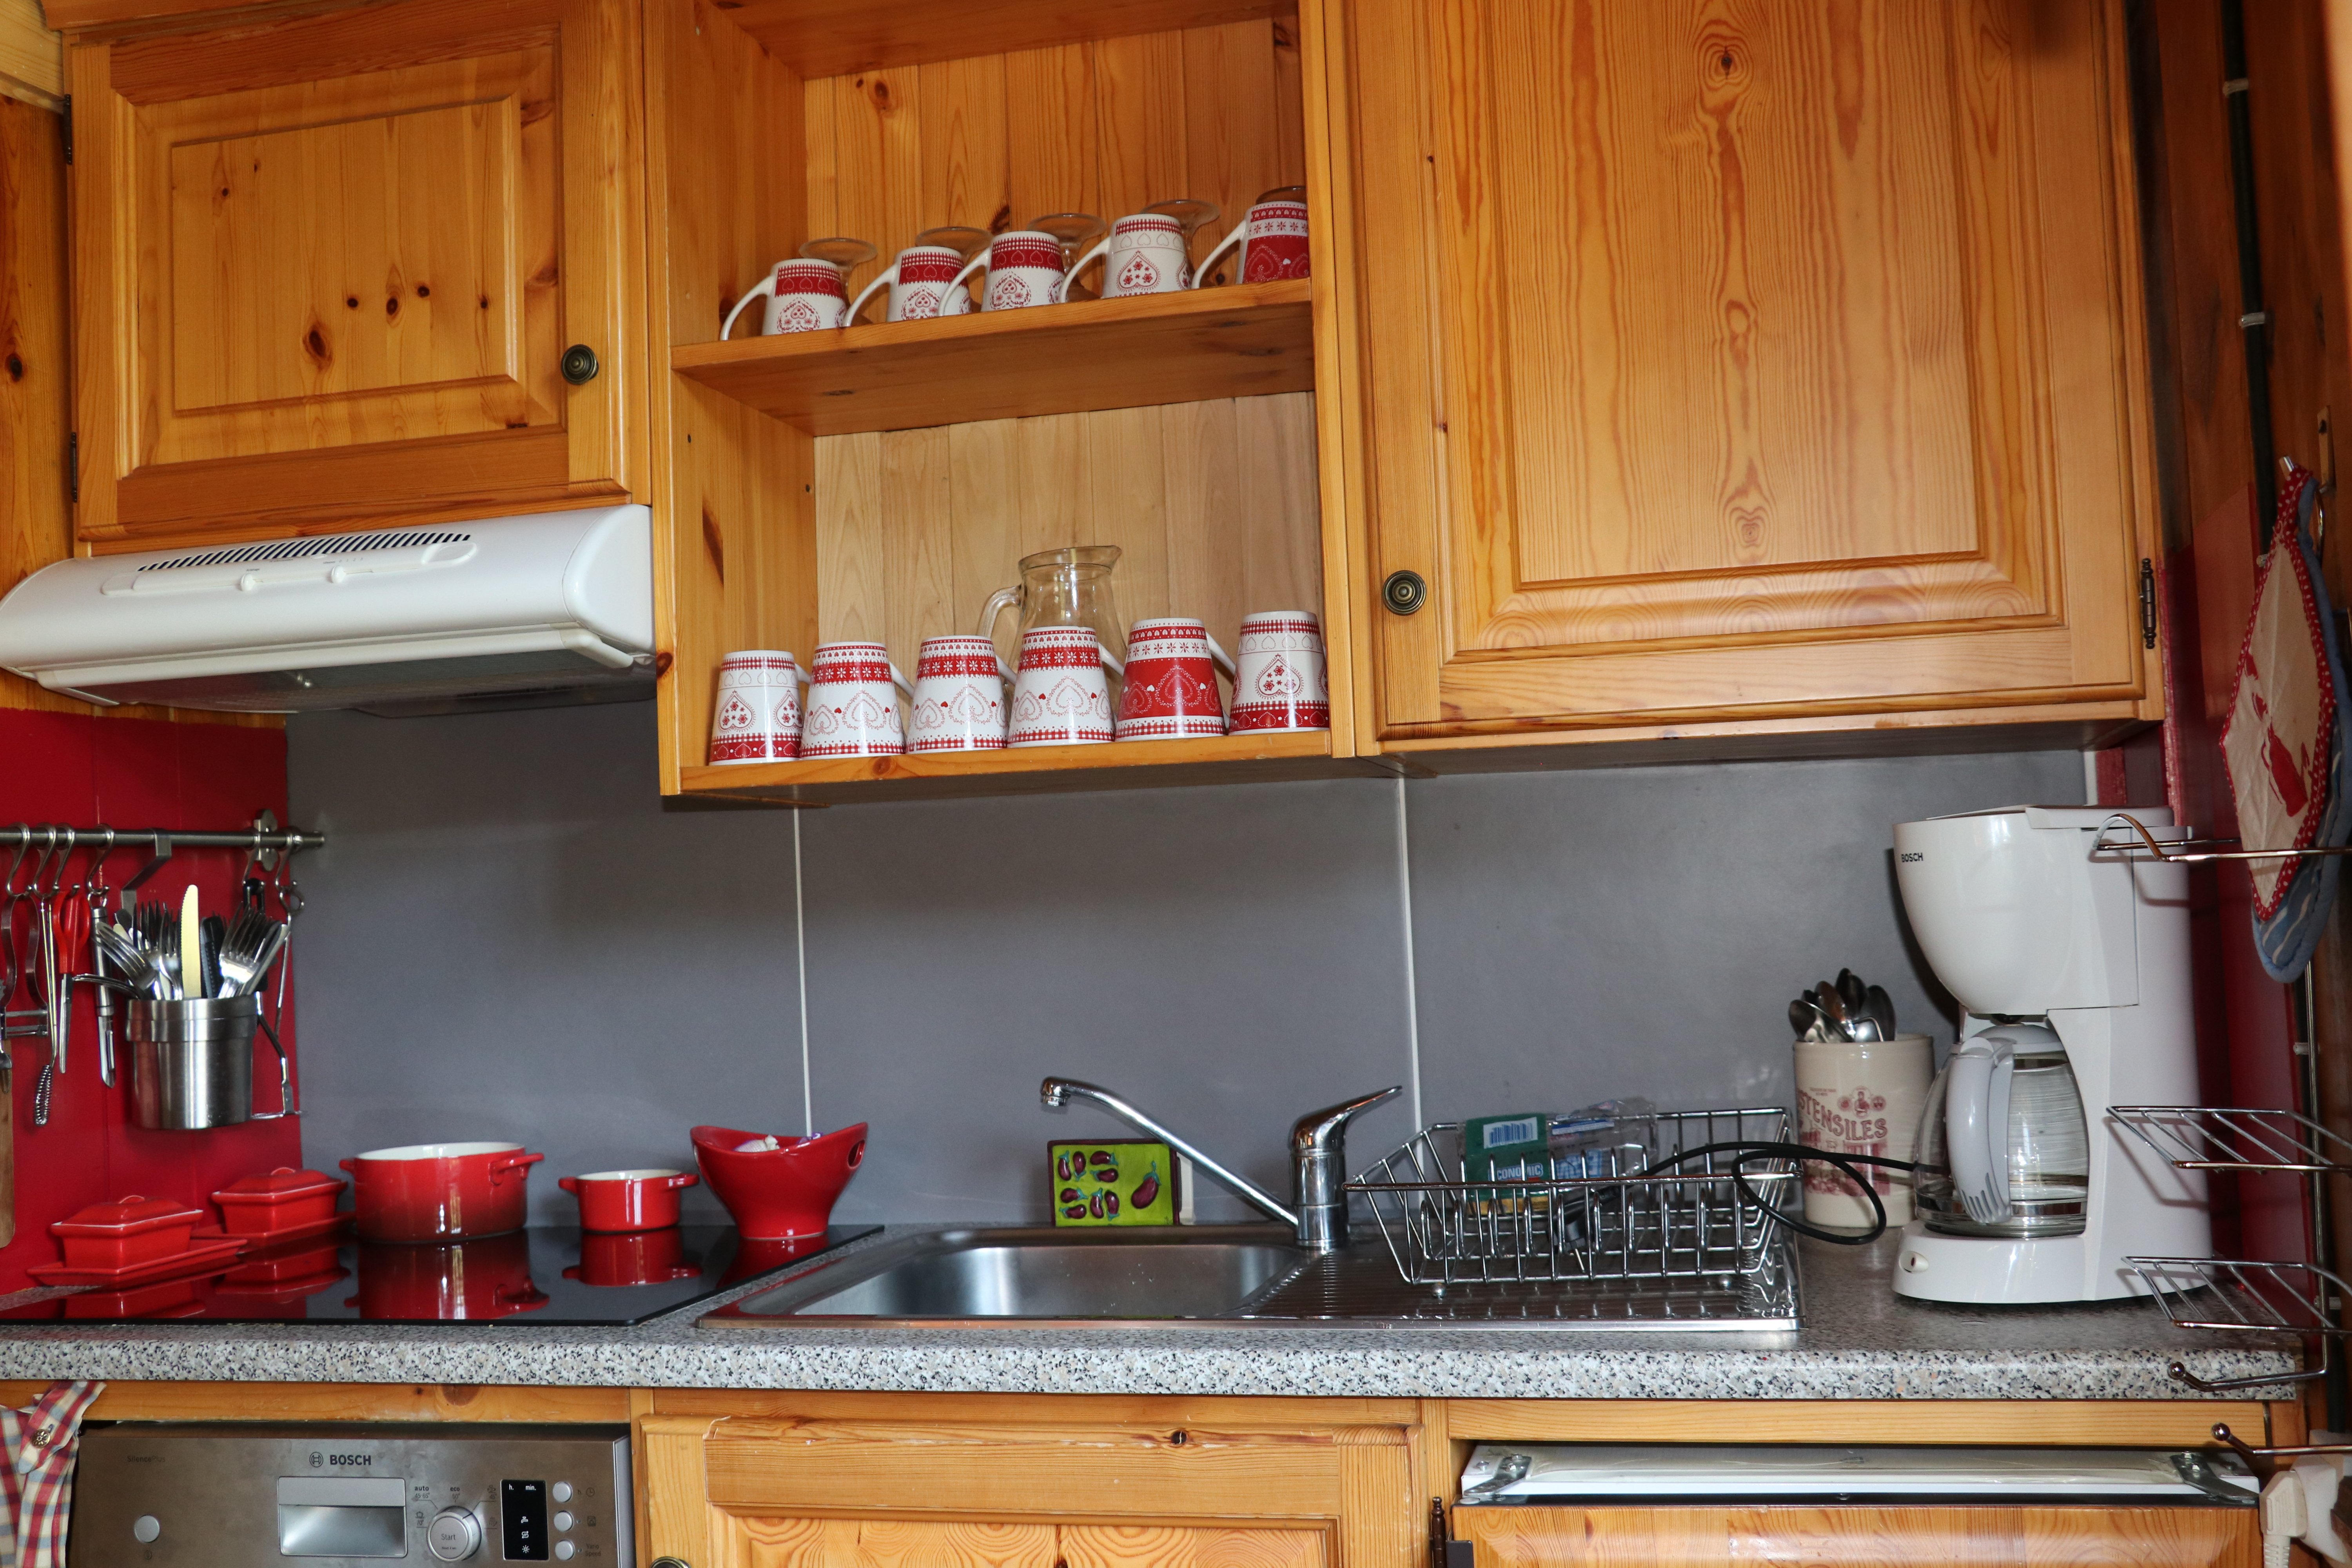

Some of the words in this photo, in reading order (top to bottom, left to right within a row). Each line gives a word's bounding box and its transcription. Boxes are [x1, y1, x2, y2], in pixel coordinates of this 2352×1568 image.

[1901, 853, 1923, 862] BOSCH
[1798, 1089, 1887, 1140] STENSILES
[330, 1454, 371, 1465] BOSCH
